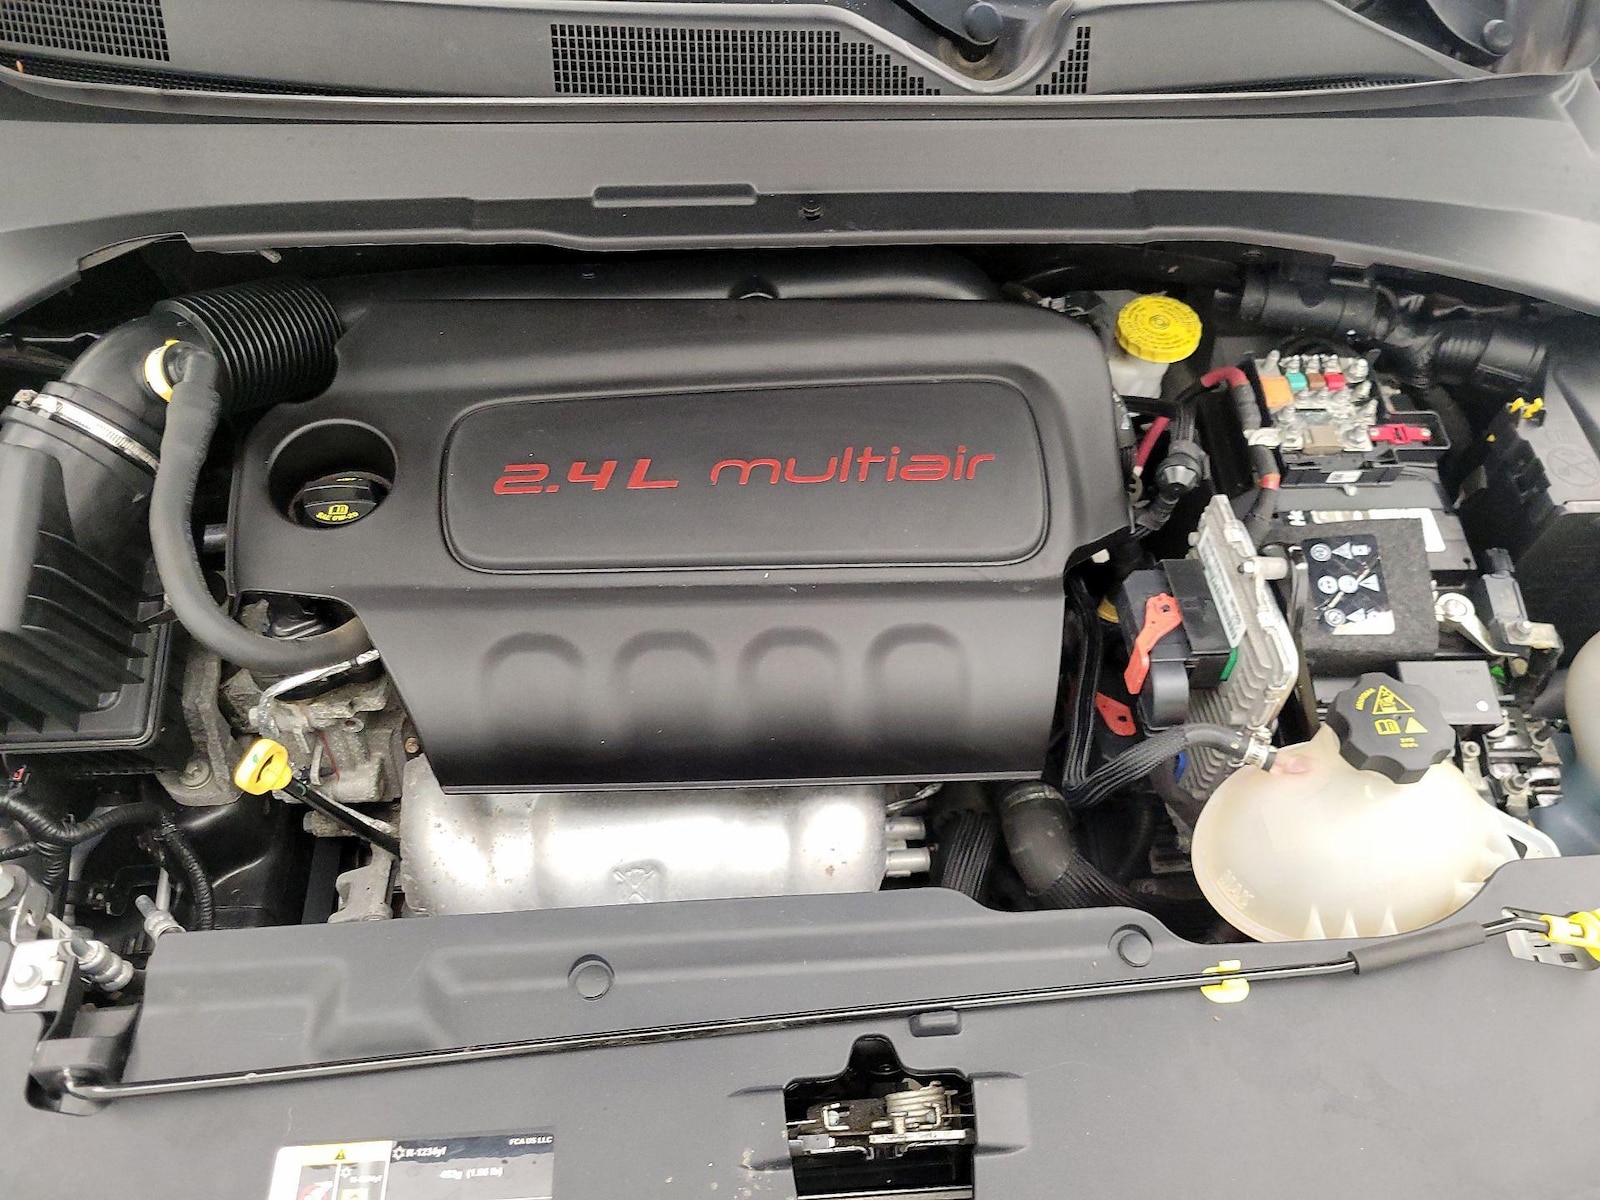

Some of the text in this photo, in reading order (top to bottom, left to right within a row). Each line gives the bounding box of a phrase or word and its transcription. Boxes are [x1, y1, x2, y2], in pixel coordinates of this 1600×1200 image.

[708, 445, 996, 486] multiair
[508, 1135, 554, 1146] FCA US LLC
